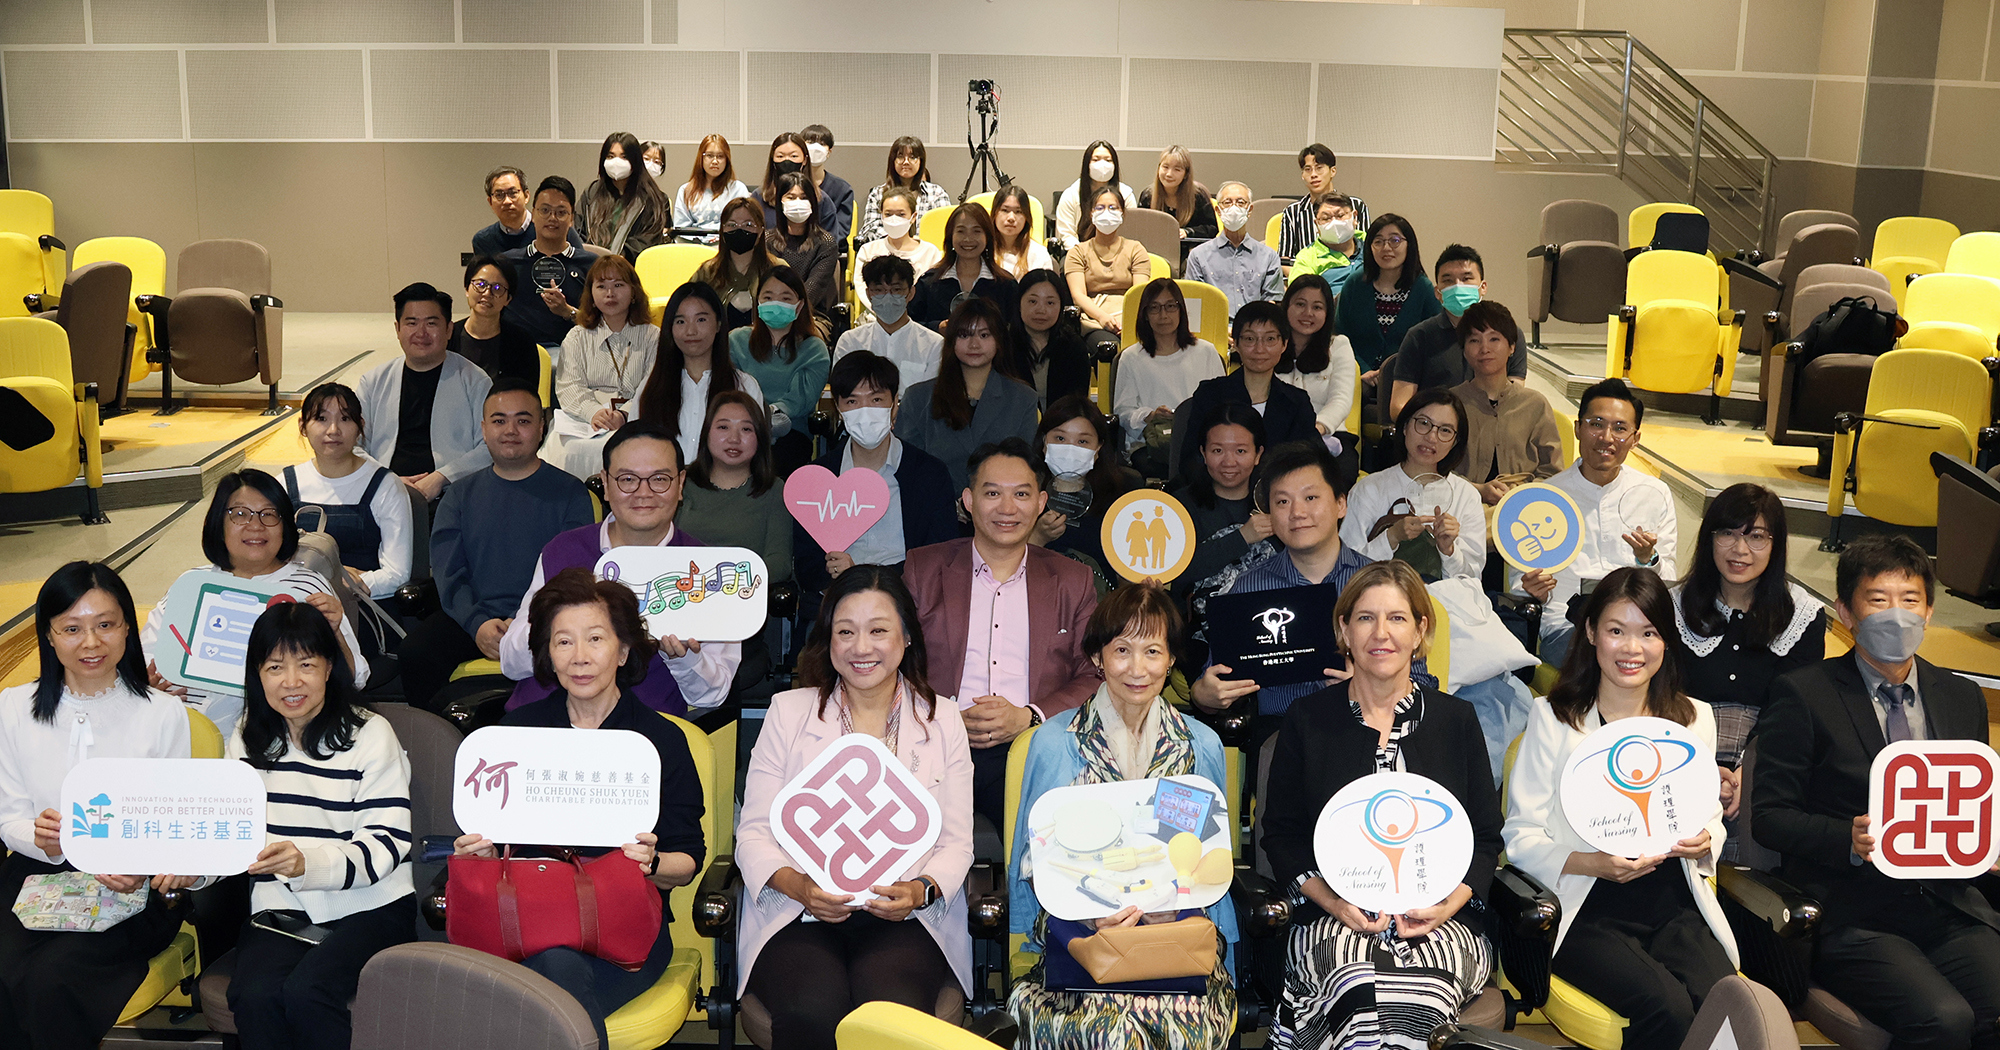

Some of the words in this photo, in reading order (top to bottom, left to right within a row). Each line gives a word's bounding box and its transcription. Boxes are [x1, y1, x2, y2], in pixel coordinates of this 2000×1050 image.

[464, 757, 519, 811] 何
[525, 786, 540, 795] HO
[543, 786, 586, 796] CHEUNG
[590, 788, 618, 797] SHUK
[621, 789, 649, 798] YUEN
[525, 795, 585, 804] CHARITABLE
[589, 797, 649, 805] FOUNDATION
[121, 806, 149, 815] FUND
[153, 806, 174, 815] FOR
[178, 806, 215, 815] BETTER
[219, 807, 253, 816] LIVING
[1589, 814, 1621, 828] School
[1623, 811, 1634, 826] of
[121, 819, 253, 840] 創科生活基金
[1597, 825, 1638, 839] Nursing
[1338, 865, 1372, 878] School
[1373, 865, 1386, 880] of
[1345, 879, 1387, 892] Nursing
